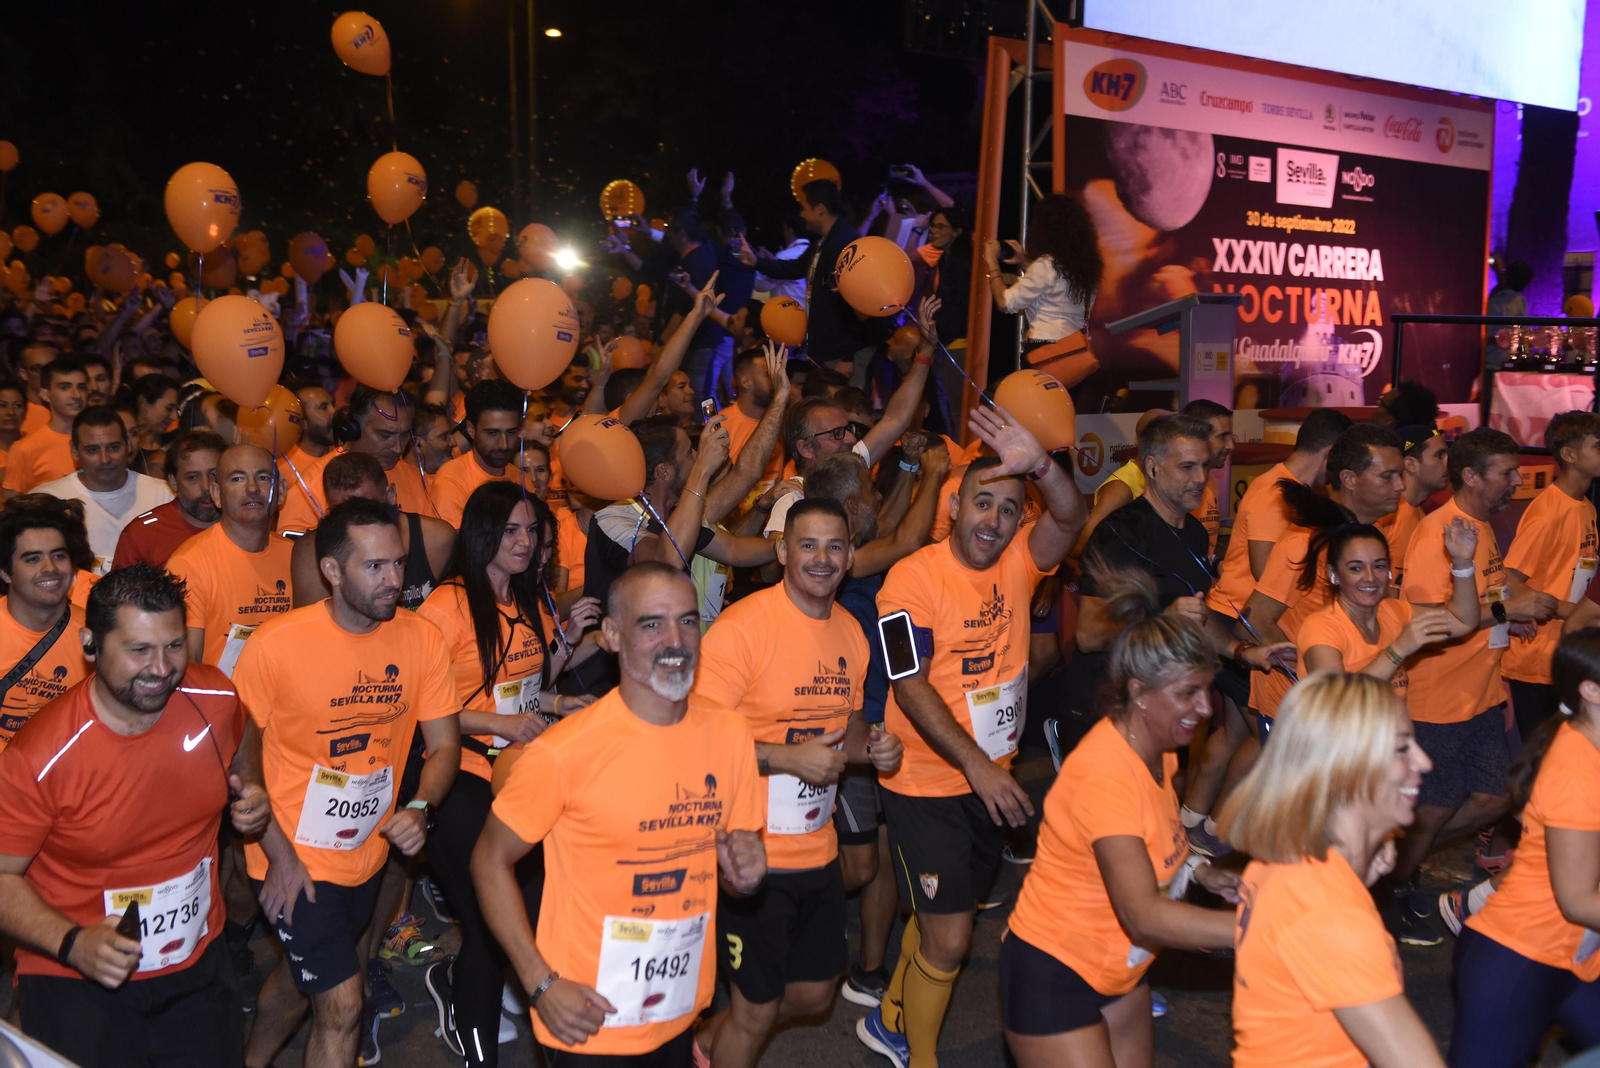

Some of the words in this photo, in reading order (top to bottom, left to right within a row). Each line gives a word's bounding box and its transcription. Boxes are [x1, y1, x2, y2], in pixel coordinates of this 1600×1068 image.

[1161, 82, 1188, 100] ABC
[1200, 91, 1254, 114] Cruzcampo
[1262, 103, 1286, 116] TORRE
[1286, 106, 1314, 120] SEVILLA
[1247, 211, 1260, 226] 30
[1261, 213, 1274, 228] de
[1276, 215, 1332, 233] septiembre
[1333, 218, 1356, 234] 2022
[1212, 237, 1287, 275] XXXIV
[1288, 243, 1384, 281] CARRERA
[1213, 284, 1383, 326] OCTURNA
[238, 606, 271, 614] SEVILLA
[508, 648, 538, 662] SEVILLA
[352, 685, 402, 693] NOCTURNA
[794, 686, 832, 697] SEVILLA
[330, 695, 373, 707] SEVILLA
[325, 797, 379, 819] 20952
[669, 801, 722, 813] NOCTURNA
[639, 816, 694, 832] SEVILLA
[140, 896, 199, 937] 12736
[631, 953, 690, 981] 16492
